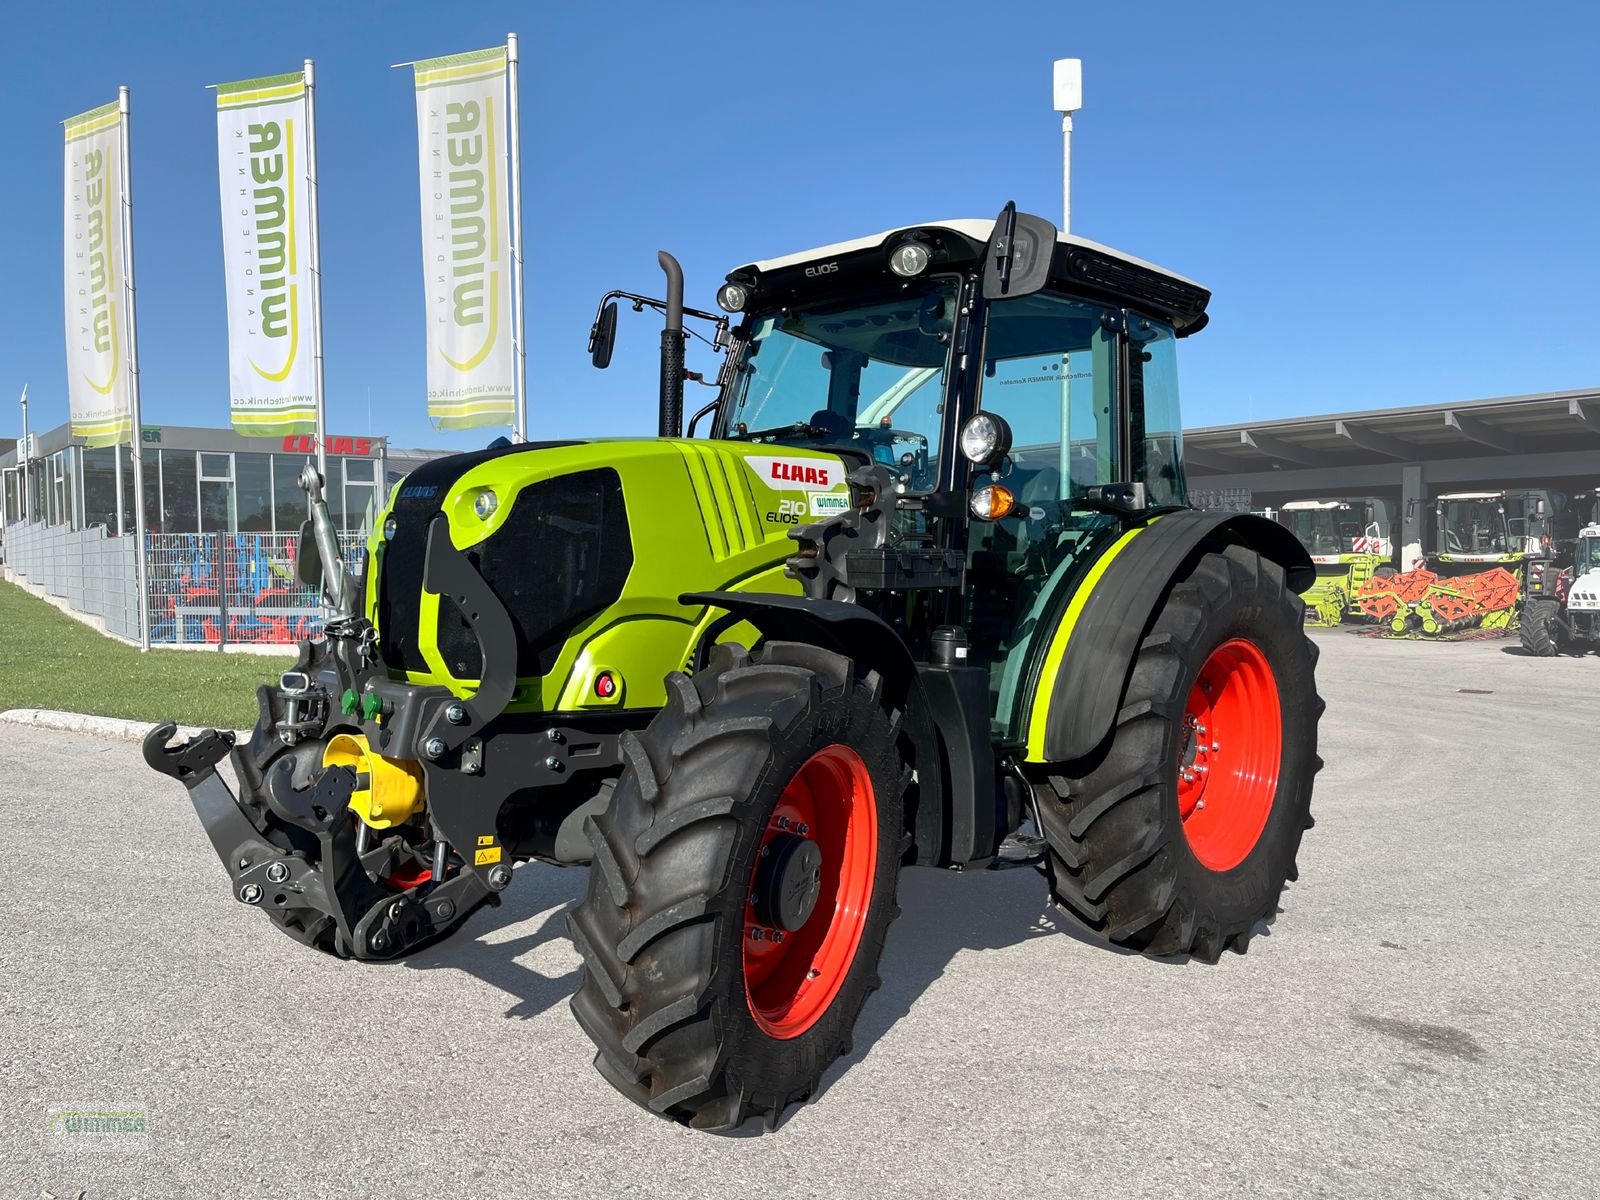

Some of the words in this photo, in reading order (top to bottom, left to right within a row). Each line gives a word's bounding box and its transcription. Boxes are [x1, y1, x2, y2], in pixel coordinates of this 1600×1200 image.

[804, 261, 839, 278] ELIOS
[771, 462, 828, 486] CLAAS
[401, 486, 438, 498] CLAAS
[778, 499, 807, 516] 210
[816, 497, 849, 508] WIMMER
[766, 511, 799, 525] ELIOS
